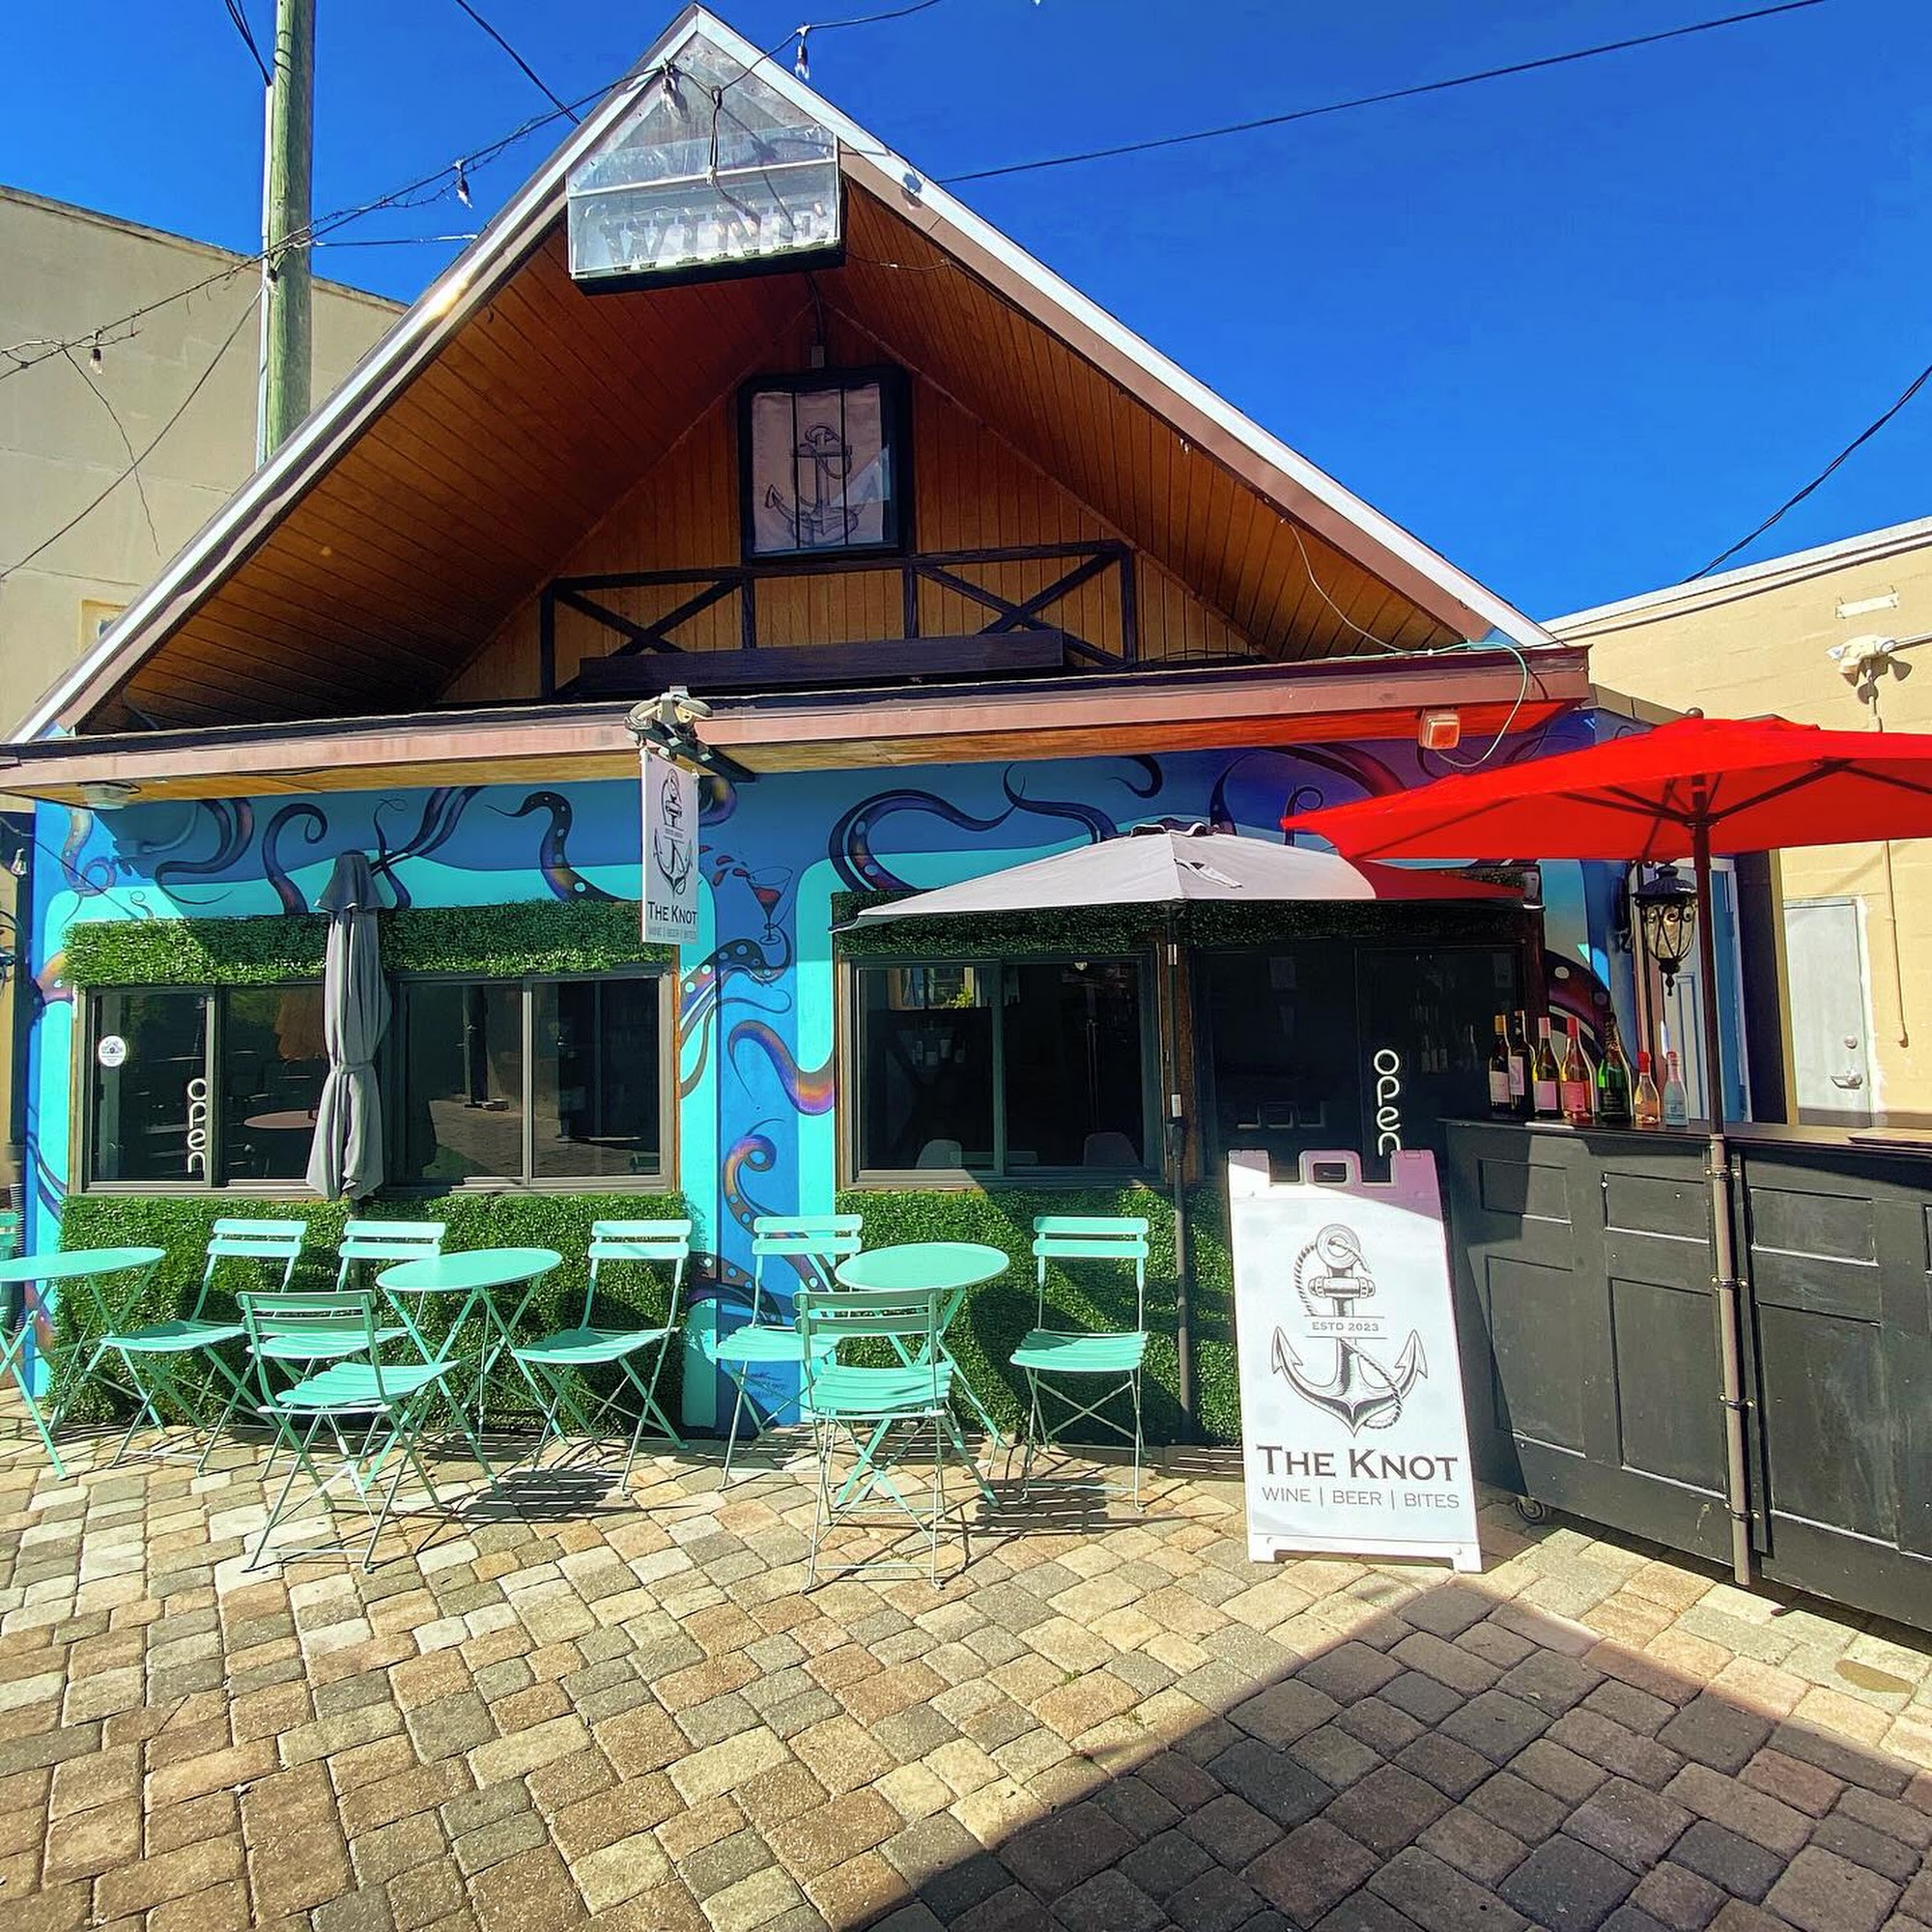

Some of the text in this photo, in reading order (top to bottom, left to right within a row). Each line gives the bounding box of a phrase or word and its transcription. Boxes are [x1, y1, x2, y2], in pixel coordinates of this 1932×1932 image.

[647, 900, 697, 924] THE KNOT
[1373, 1048, 1402, 1157] open
[186, 1077, 207, 1174] open
[1312, 1321, 1379, 1332] ESTD 2023
[1256, 1443, 1459, 1482] THE KNOT
[1262, 1487, 1312, 1503] WINE
[1331, 1490, 1382, 1506] BEER
[1404, 1492, 1460, 1509] BITES
